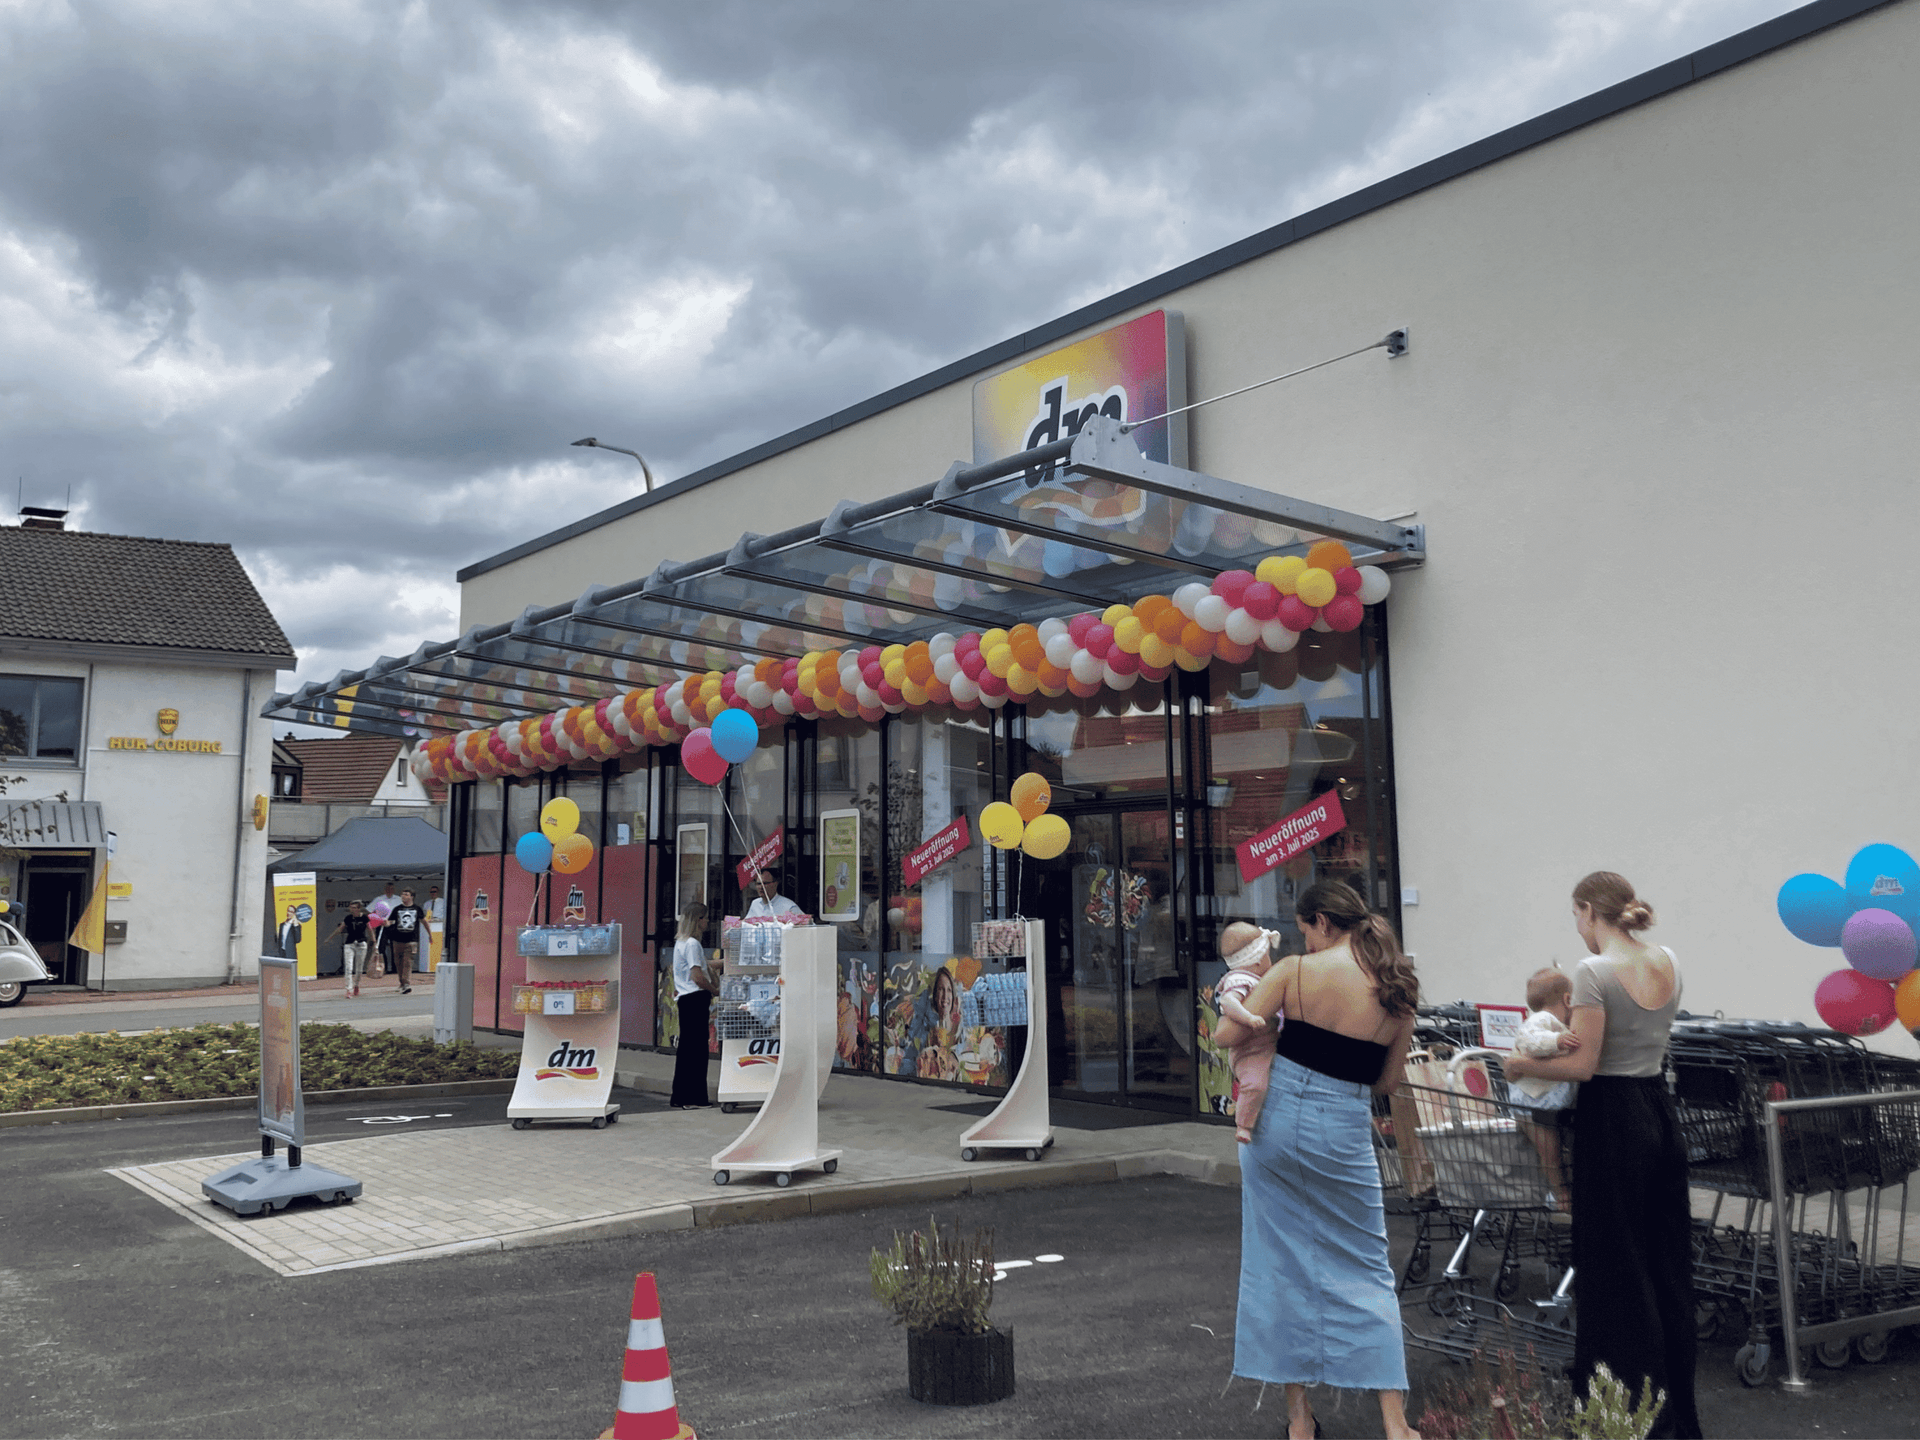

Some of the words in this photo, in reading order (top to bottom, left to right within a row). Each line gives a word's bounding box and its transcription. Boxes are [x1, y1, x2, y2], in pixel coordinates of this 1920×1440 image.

[109, 736, 222, 754] HUK-COBURG
[1249, 805, 1328, 859] Neueröffnung
[910, 826, 960, 869] Neueröffnung
[1265, 852, 1279, 867] am
[1277, 847, 1287, 859] 3.
[1286, 836, 1301, 855] Juli
[1300, 826, 1321, 846] 2025
[475, 889, 488, 909] dm
[568, 885, 584, 908] dm
[548, 1041, 596, 1068] dm
